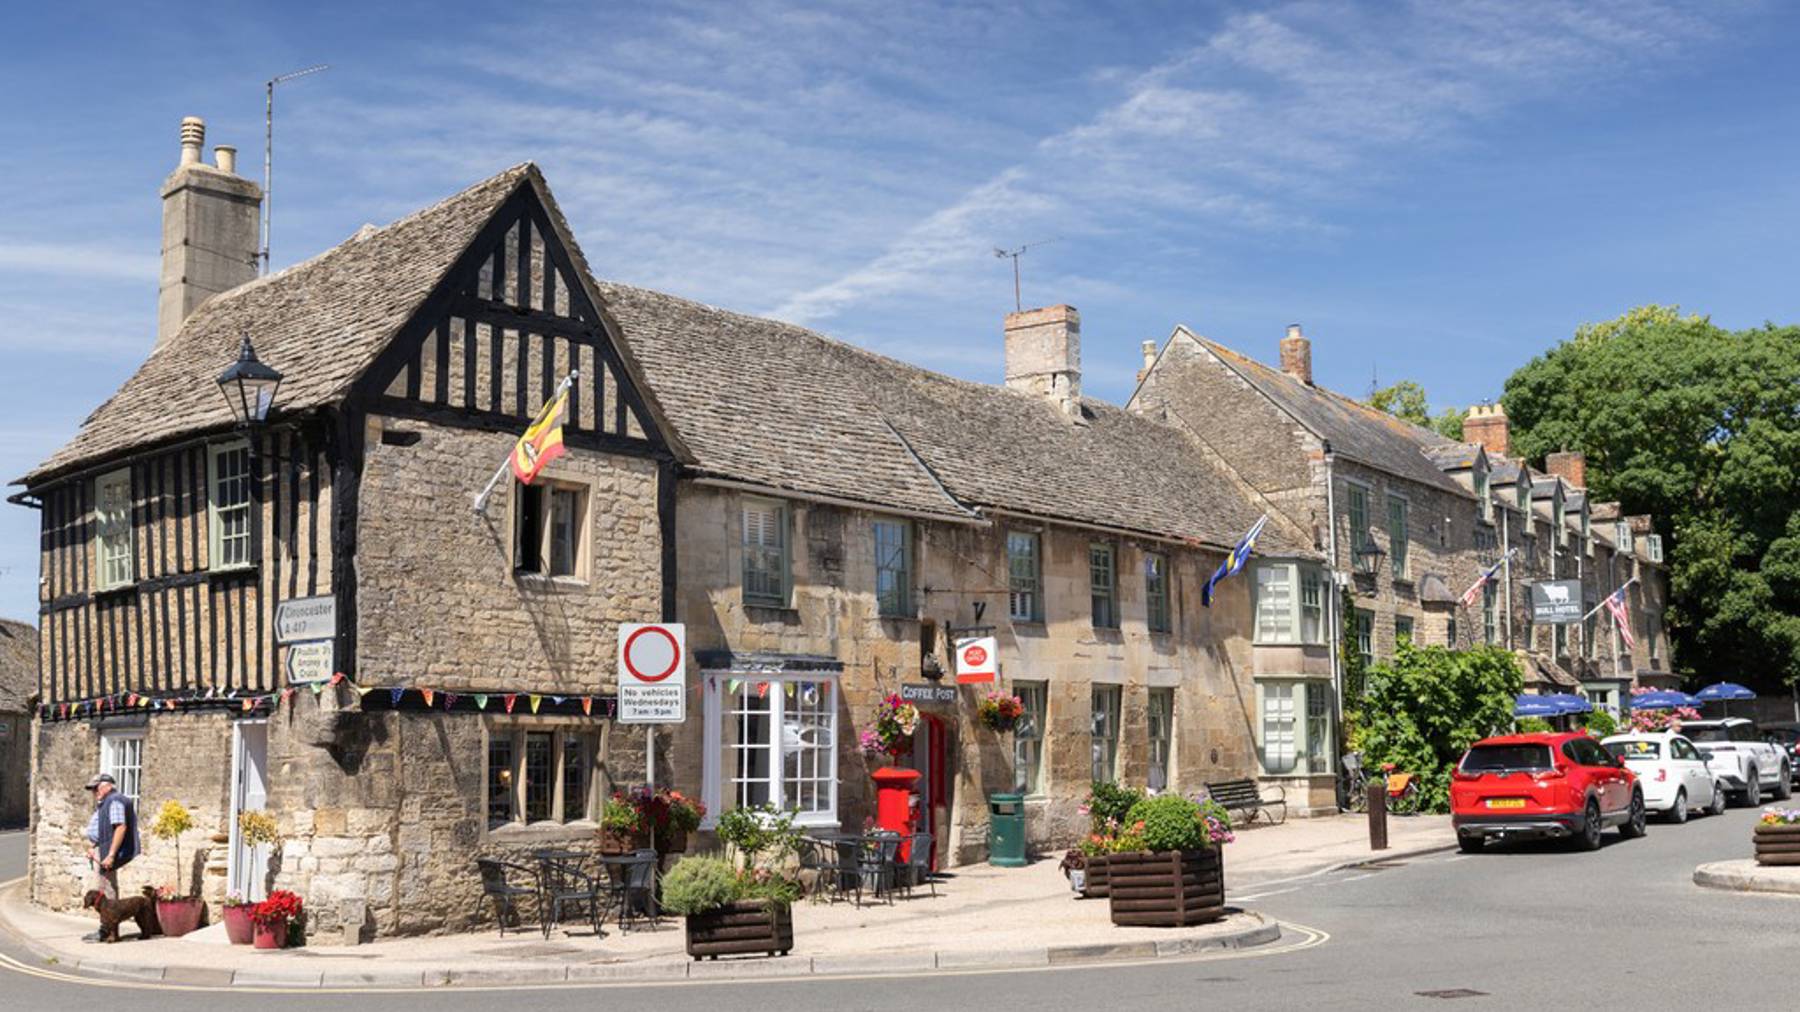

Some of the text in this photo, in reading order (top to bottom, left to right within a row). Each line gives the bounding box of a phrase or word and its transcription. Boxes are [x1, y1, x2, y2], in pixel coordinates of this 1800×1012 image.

[1535, 605, 1579, 615] BULL HOTEL
[624, 688, 678, 696] No vehicles
[903, 686, 955, 700] COFFEE POST
[624, 698, 679, 707] Wednesdays
